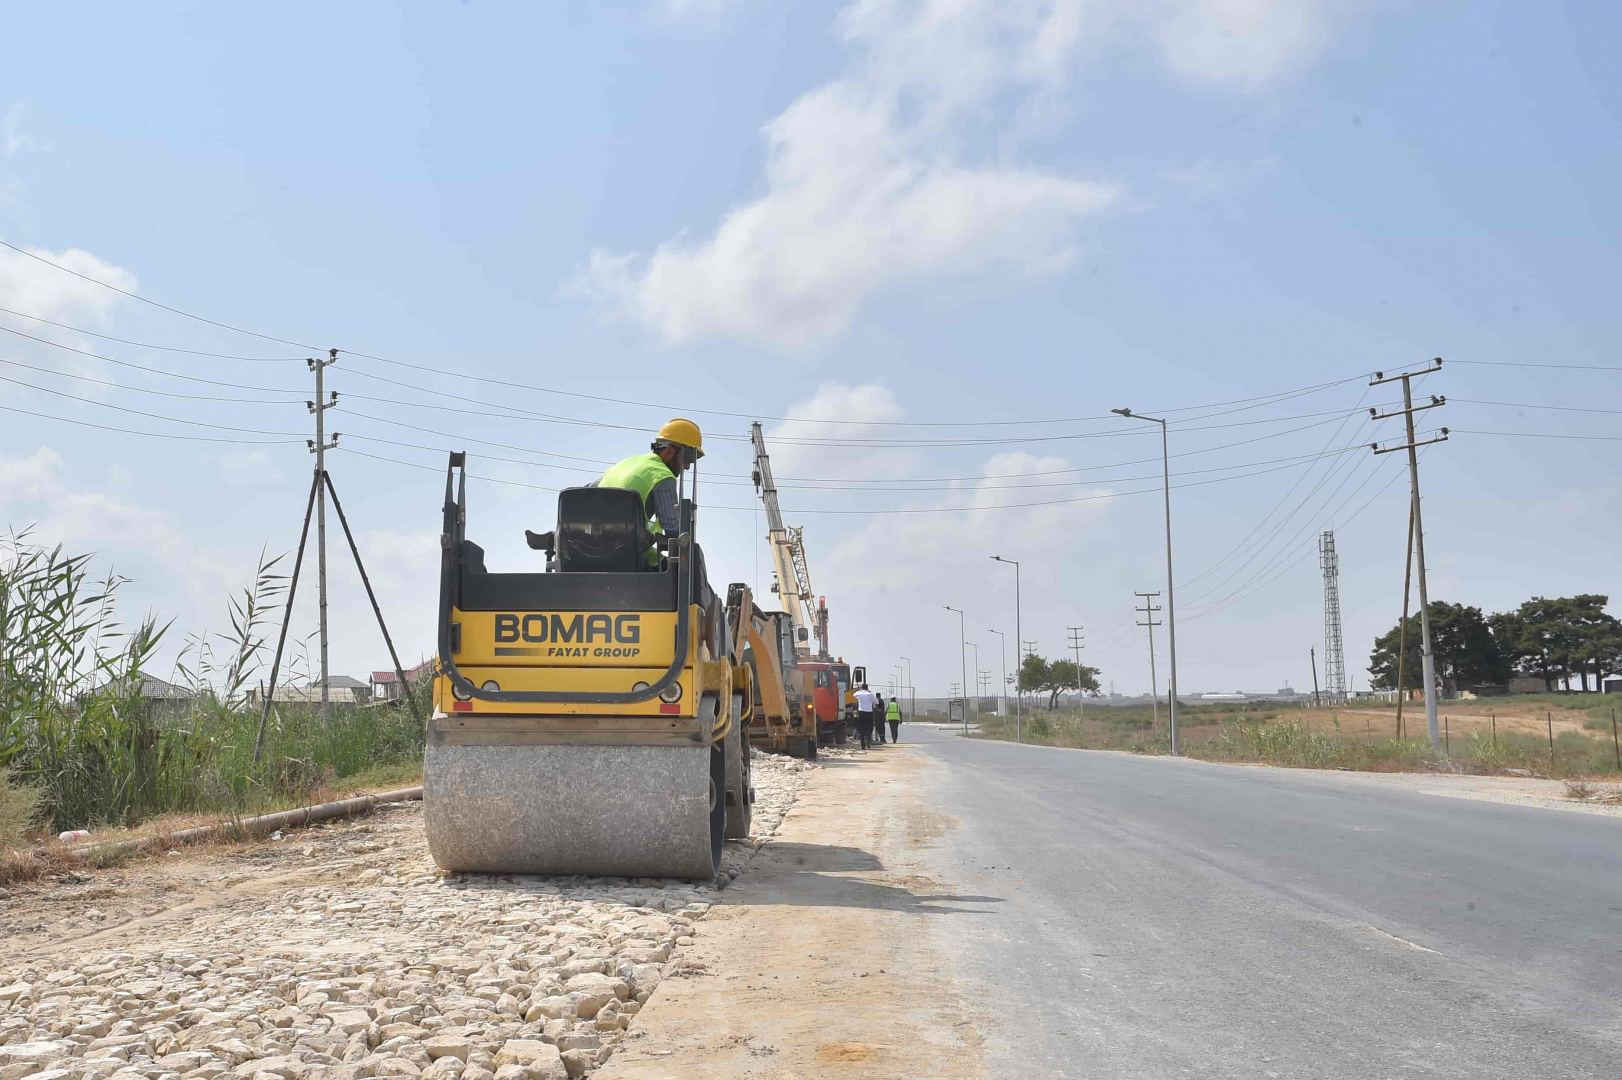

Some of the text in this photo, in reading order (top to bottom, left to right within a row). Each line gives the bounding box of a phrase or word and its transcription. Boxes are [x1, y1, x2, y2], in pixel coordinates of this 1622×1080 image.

[495, 614, 640, 643] BOMAG
[547, 647, 640, 657] FAYAT GROUP
